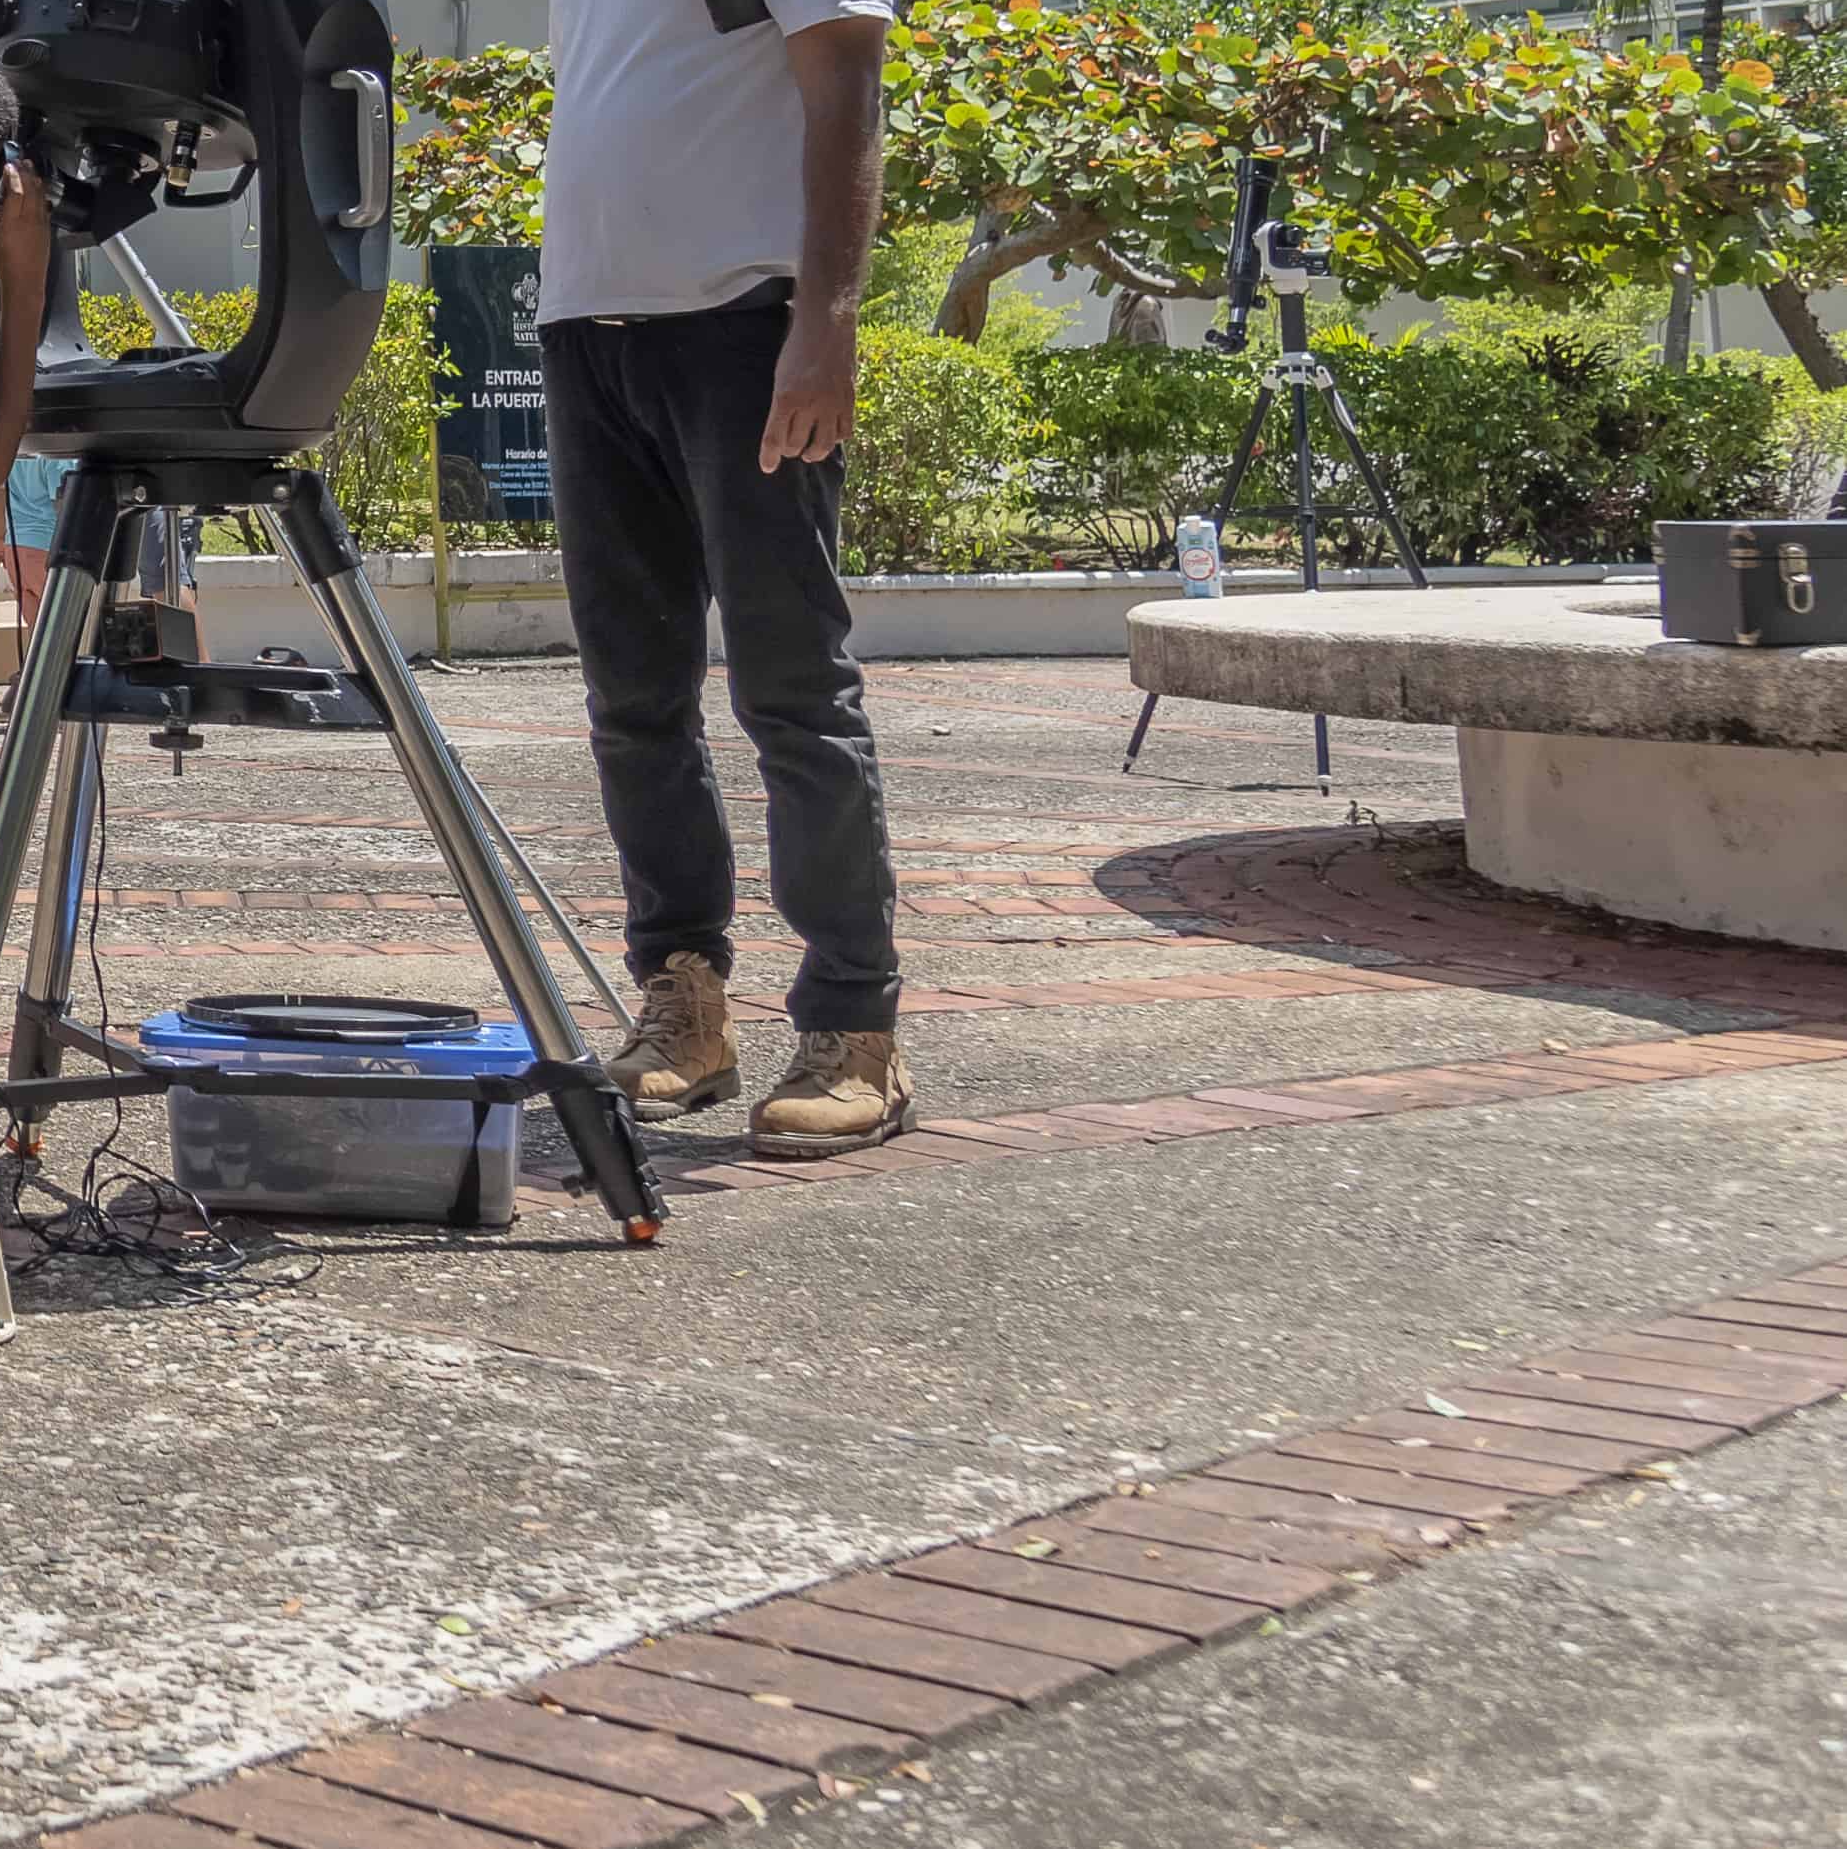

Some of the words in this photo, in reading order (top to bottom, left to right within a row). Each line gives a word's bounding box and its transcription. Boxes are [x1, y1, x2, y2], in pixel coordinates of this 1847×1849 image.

[485, 370, 543, 386] ENTRAD
[472, 392, 492, 408] LA
[494, 392, 547, 408] PUERTA
